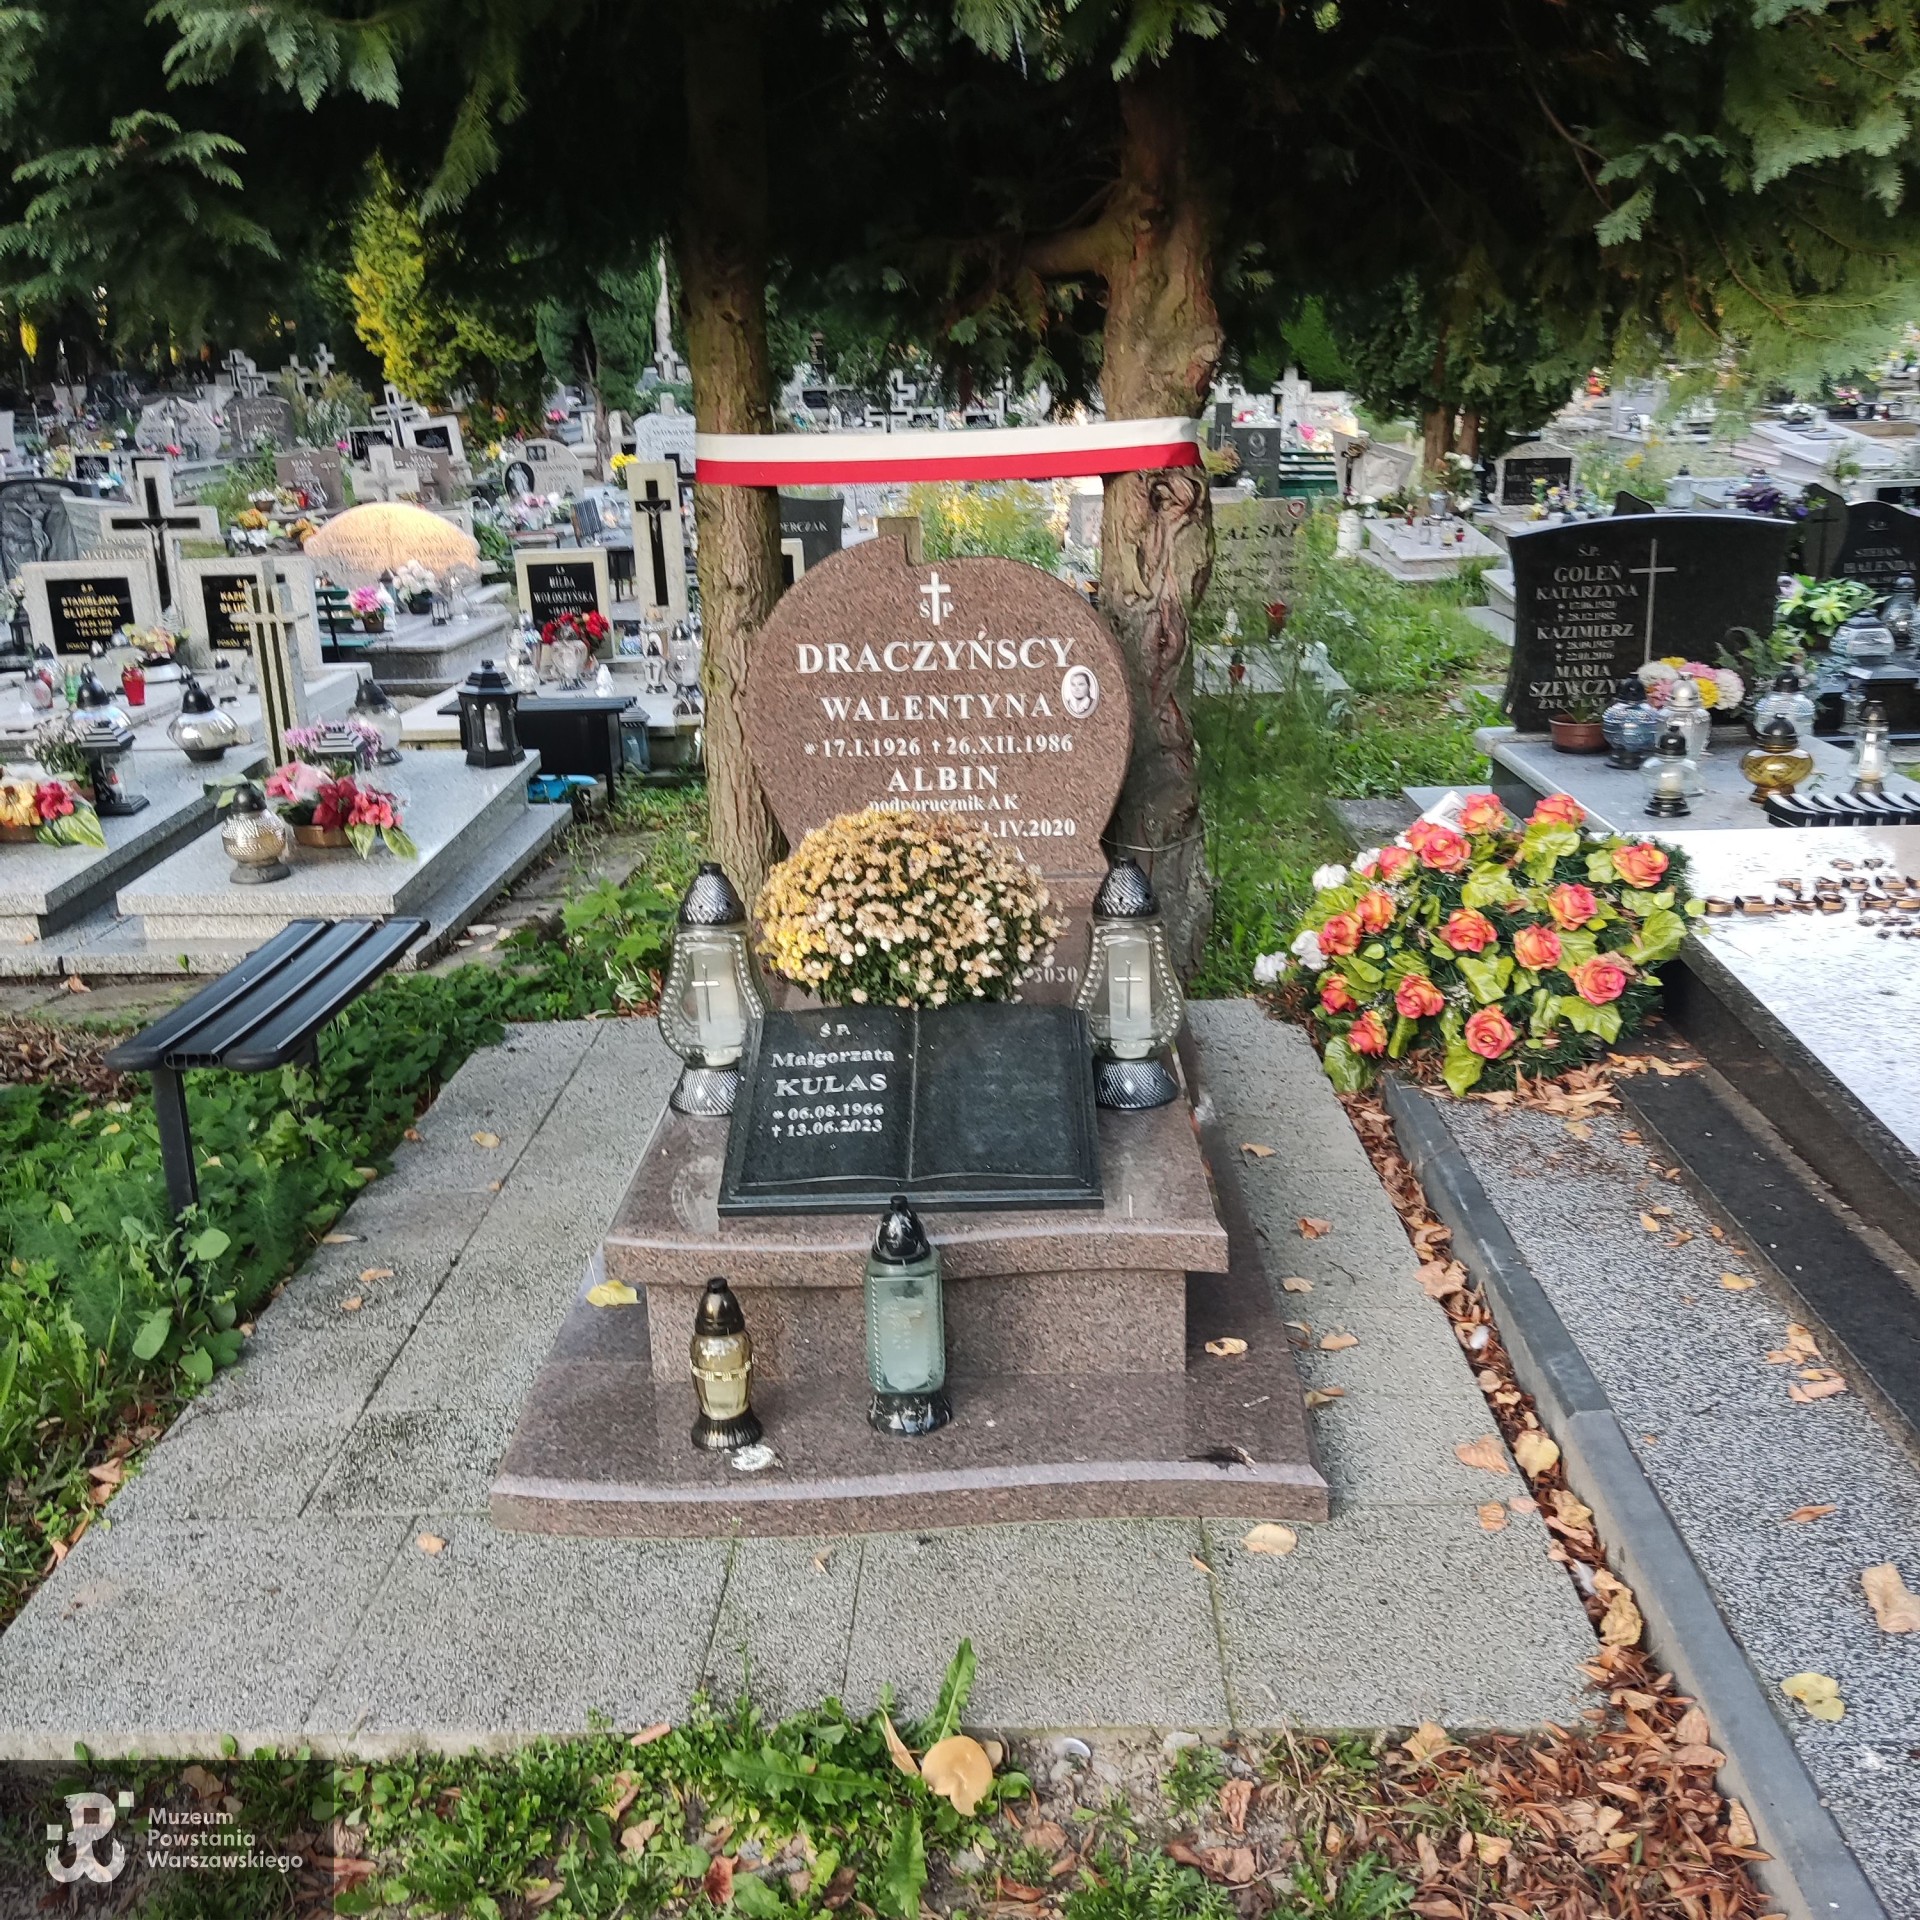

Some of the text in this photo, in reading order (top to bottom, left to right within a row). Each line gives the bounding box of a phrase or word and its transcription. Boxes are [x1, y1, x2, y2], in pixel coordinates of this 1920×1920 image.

[1536, 584, 1639, 601] KATARZYNA
[1537, 624, 1635, 641] KAZIMIERZ
[797, 631, 1076, 674] DRACZYŃSCY
[1554, 664, 1612, 679] MARIA
[1528, 678, 1618, 698] SZEWCZY
[821, 692, 1053, 722] WALENTYNA
[823, 733, 1074, 758] 17.I.1926 26.XII.1986
[887, 765, 999, 792] ALBIN
[773, 1073, 888, 1097] KULAS
[787, 1102, 885, 1120] 06.08.1966
[787, 1118, 883, 1137] 13.06.2023
